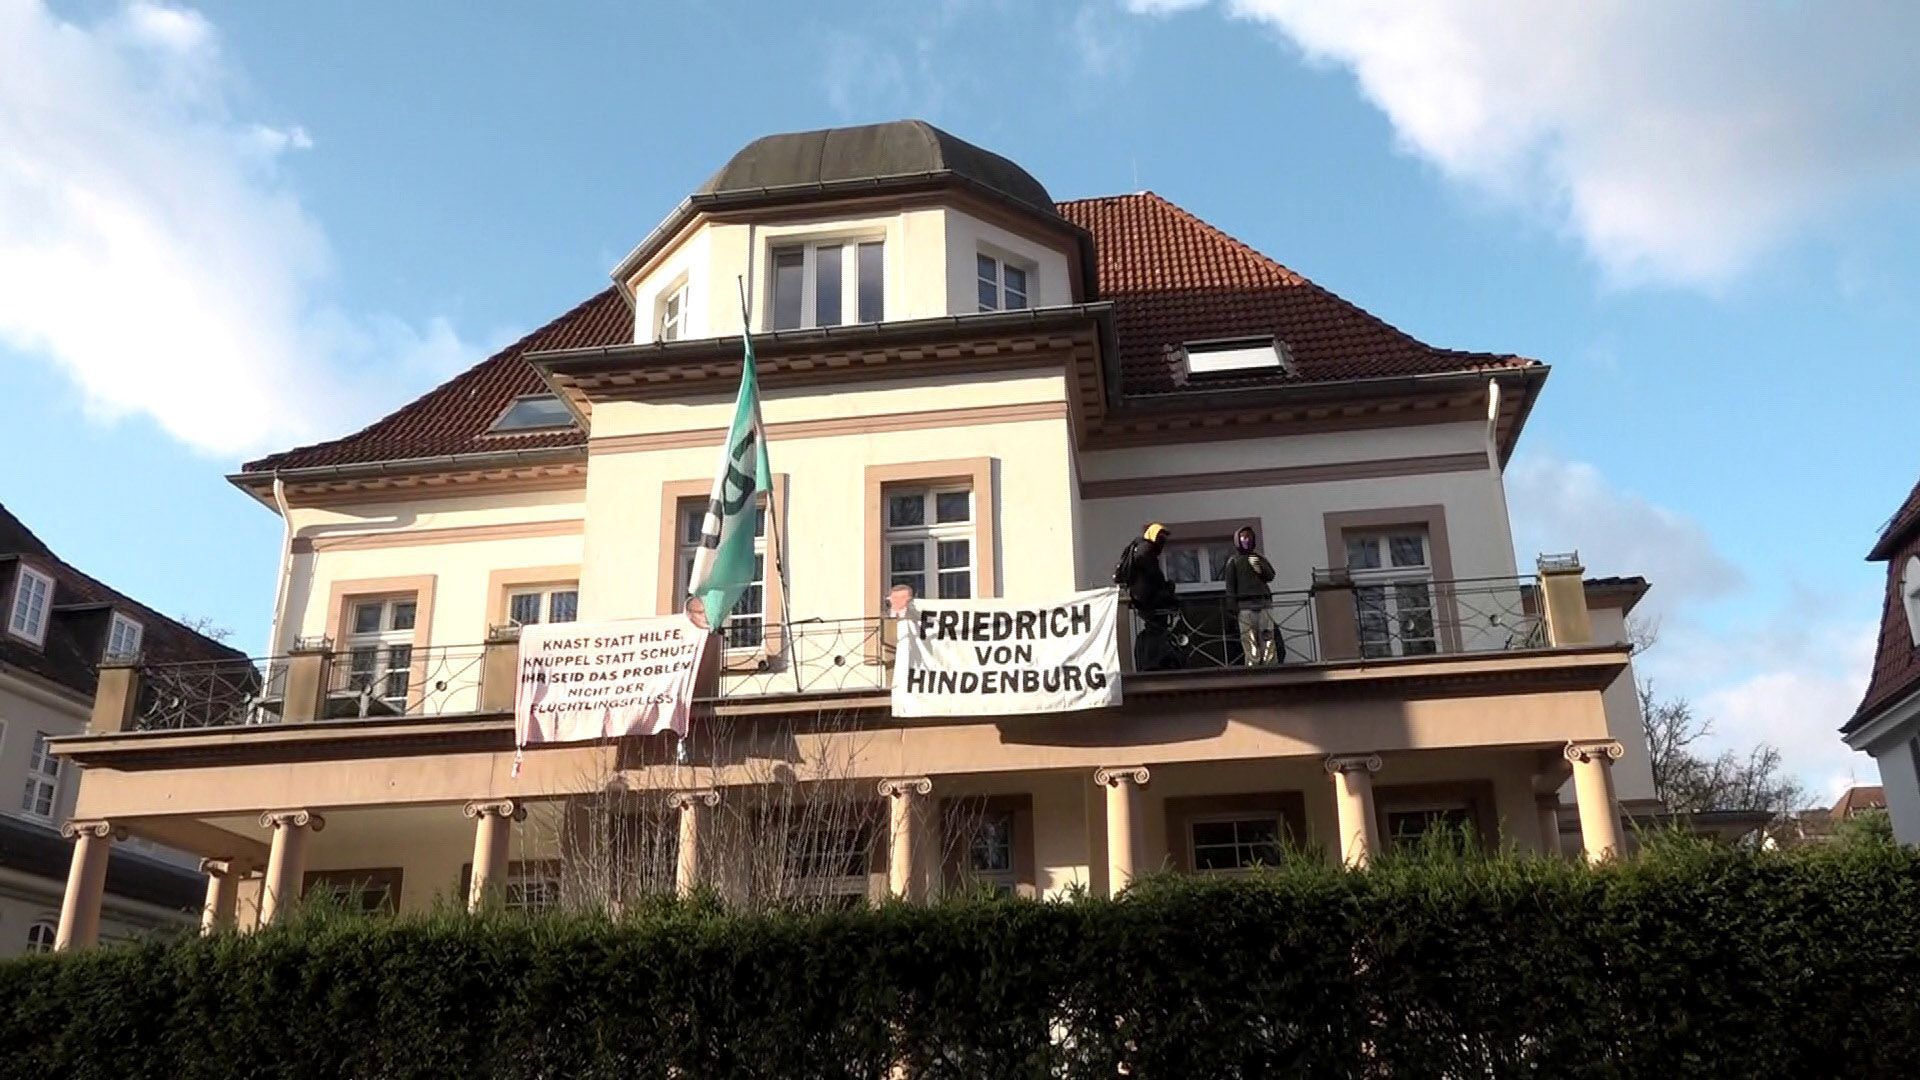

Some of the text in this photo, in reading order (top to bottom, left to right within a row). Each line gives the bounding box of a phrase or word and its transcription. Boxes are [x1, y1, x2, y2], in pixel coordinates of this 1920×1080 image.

[920, 604, 1091, 641] FRIEDRICH
[543, 638, 590, 651] KNAST
[594, 634, 635, 648] STATT
[595, 652, 635, 665] STATT
[640, 644, 694, 661] SCHUTZ
[974, 644, 1032, 666] VON
[522, 673, 546, 684] IHR
[551, 672, 584, 683] SEID
[589, 670, 617, 682] DAS
[907, 663, 1106, 694] HINDENBURG
[568, 683, 645, 697] NICHT DER
